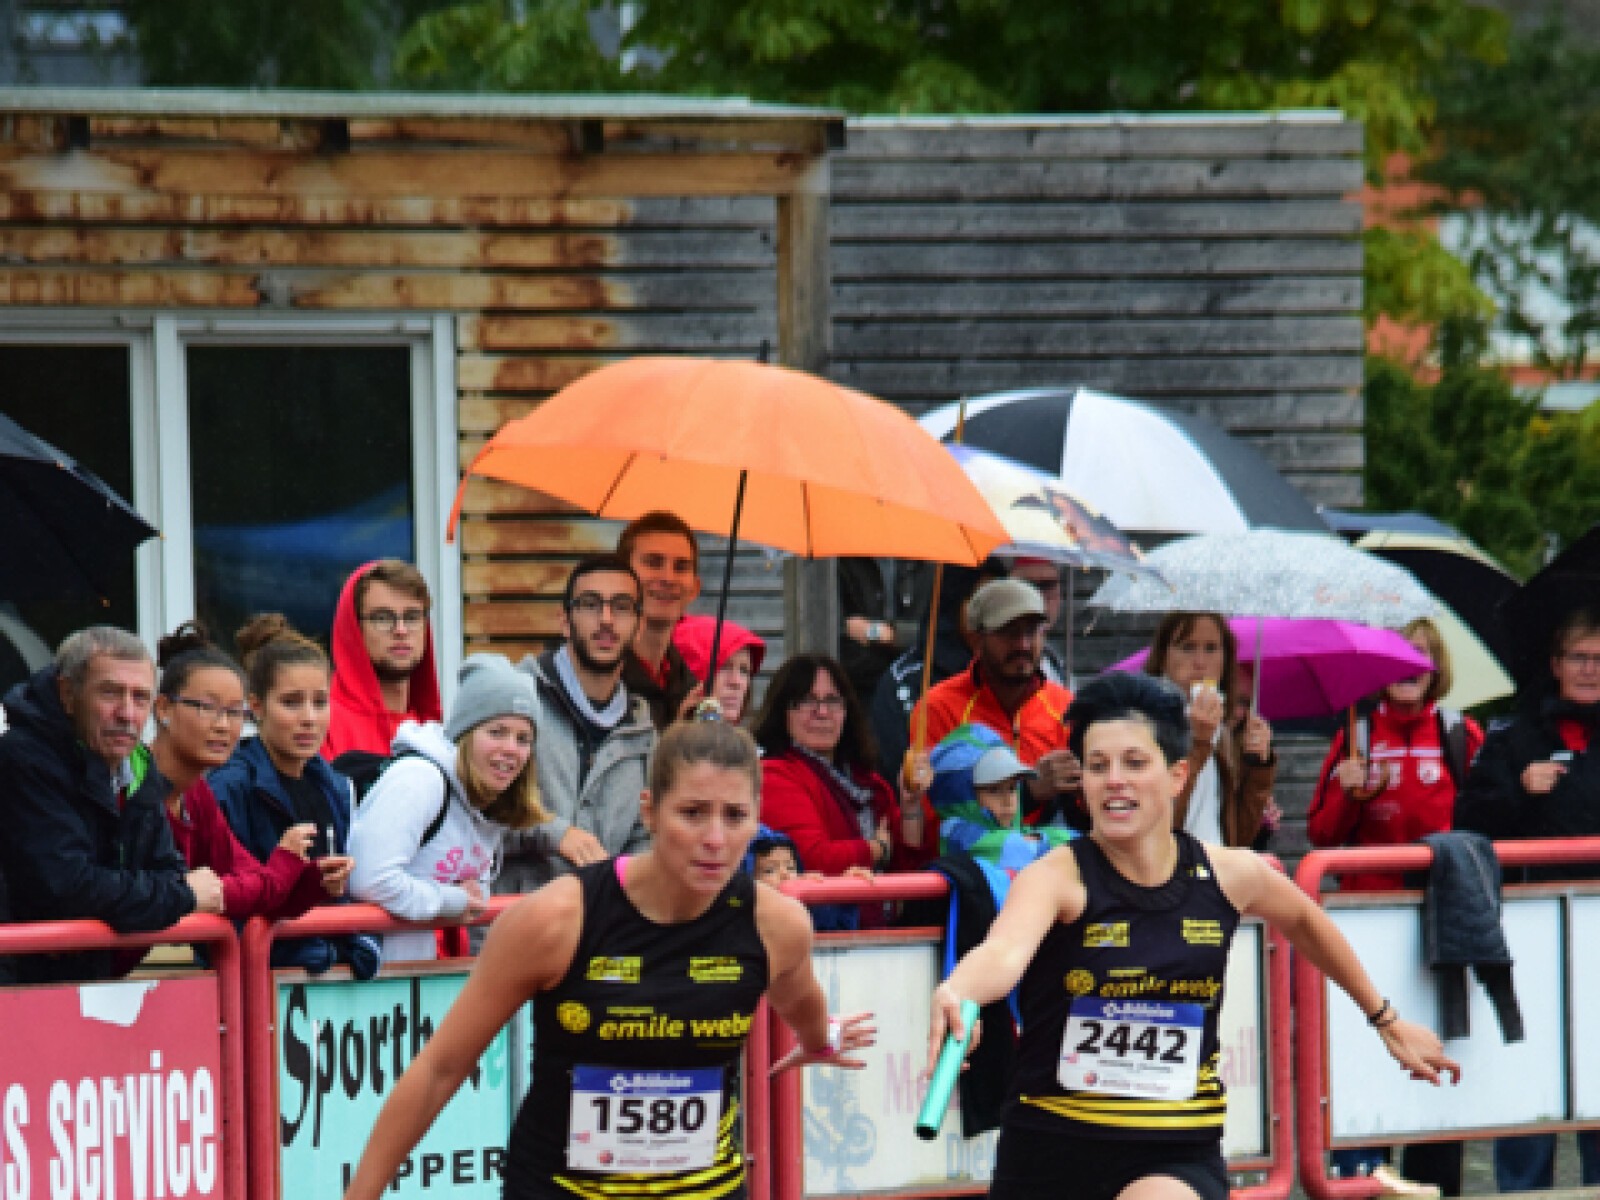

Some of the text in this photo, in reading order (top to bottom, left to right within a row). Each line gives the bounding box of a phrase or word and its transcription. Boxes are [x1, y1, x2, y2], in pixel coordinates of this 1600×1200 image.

[599, 1013, 684, 1040] emile
[1074, 1020, 1188, 1064] 2442
[280, 977, 508, 1148] Sporth
[590, 1096, 707, 1134] 1580
[341, 1146, 507, 1193] PPER
